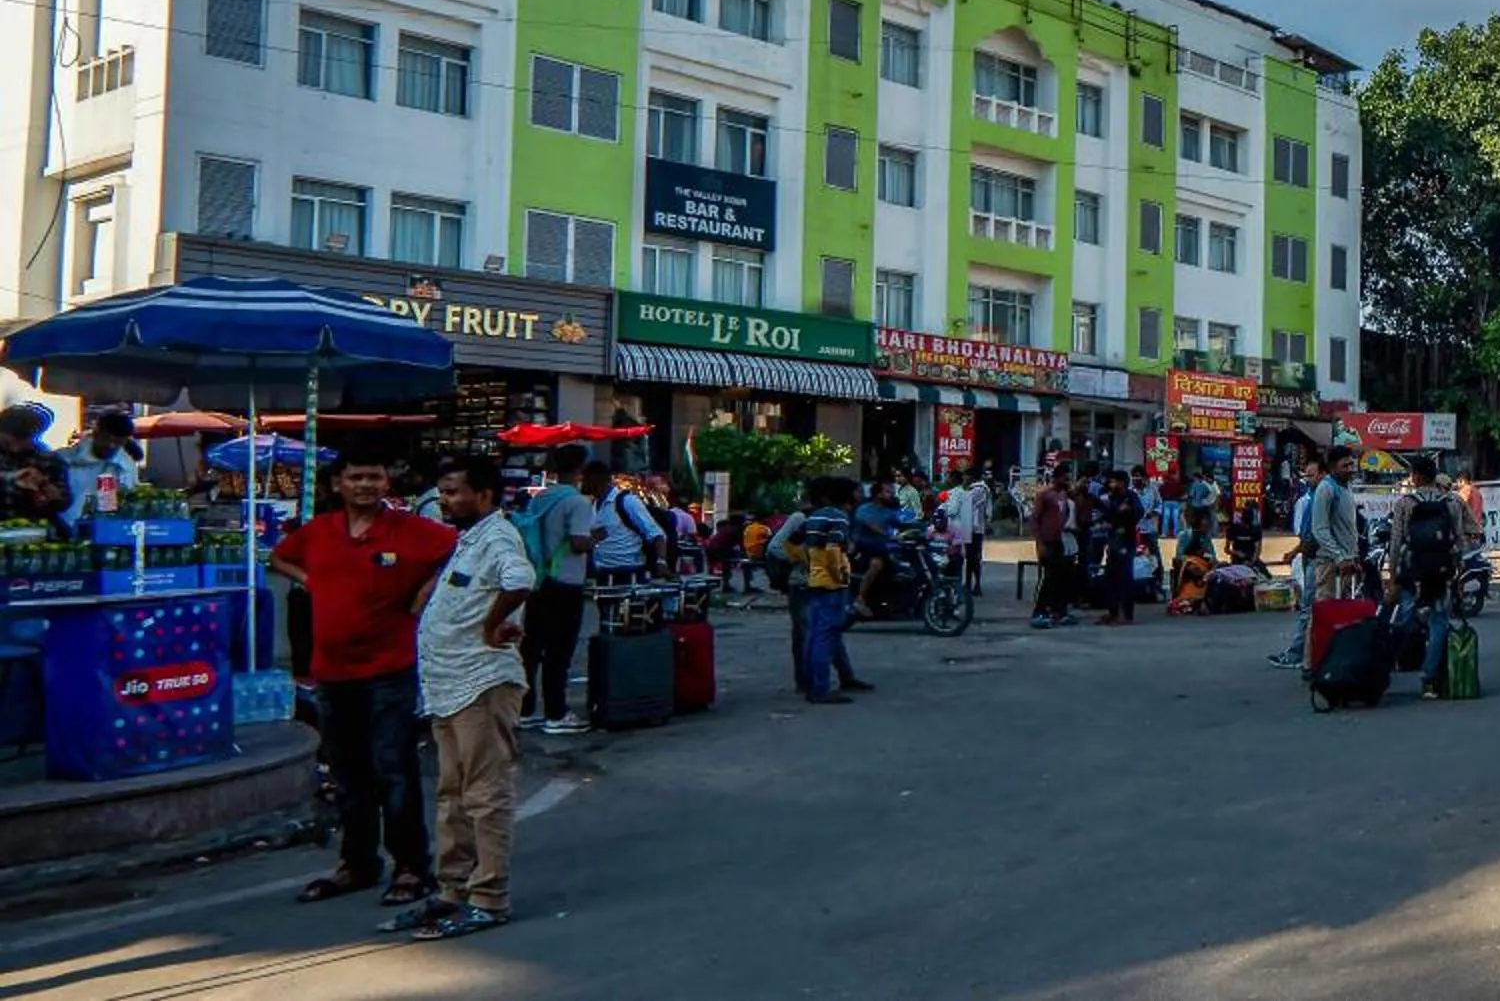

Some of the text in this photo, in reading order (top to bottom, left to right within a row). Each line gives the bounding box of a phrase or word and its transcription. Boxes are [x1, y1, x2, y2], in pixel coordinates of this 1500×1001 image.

[685, 200, 719, 219] BAR
[724, 207, 737, 222] &
[654, 212, 765, 242] RESTAURANT
[444, 305, 539, 340] FRUIT
[639, 304, 710, 327] HOTEL
[875, 329, 1071, 369] HARI BHOJANALAYA
[120, 679, 149, 695] Jio
